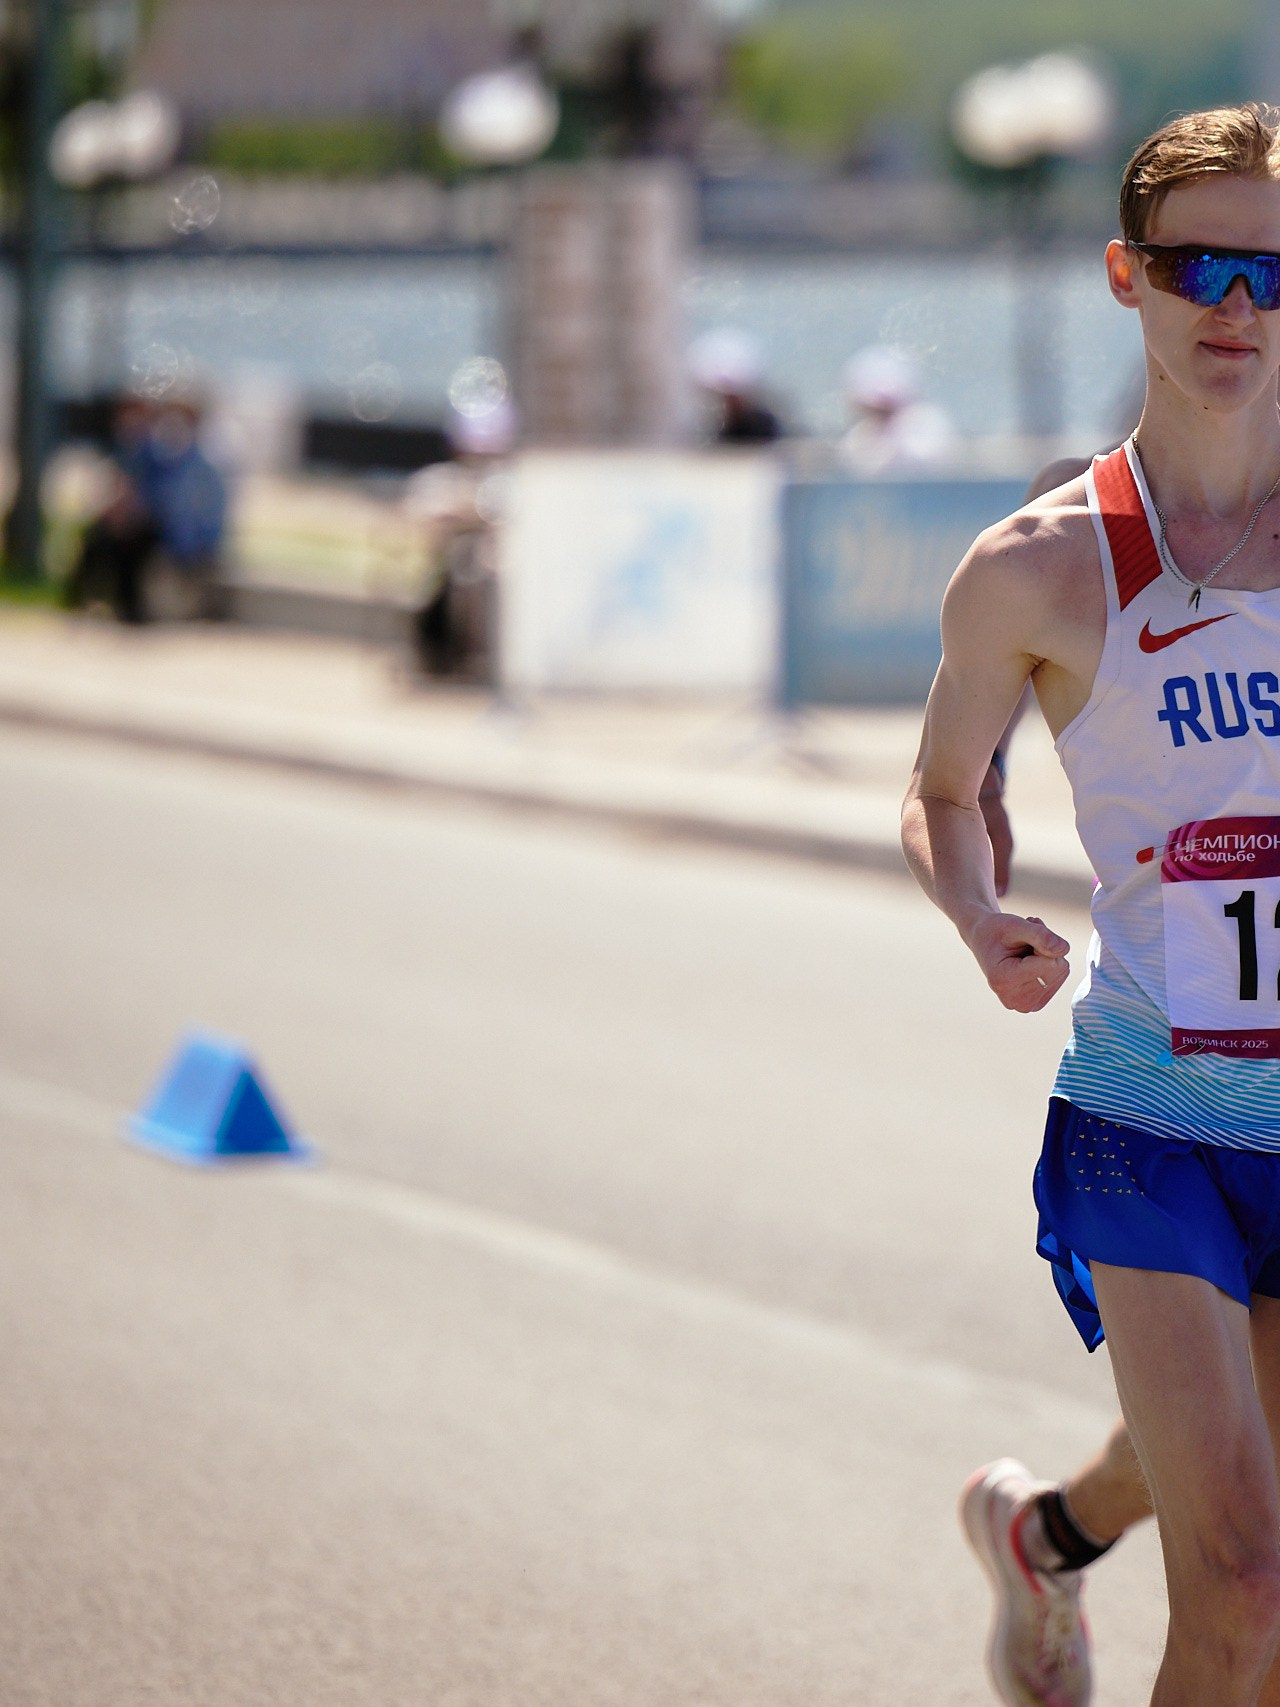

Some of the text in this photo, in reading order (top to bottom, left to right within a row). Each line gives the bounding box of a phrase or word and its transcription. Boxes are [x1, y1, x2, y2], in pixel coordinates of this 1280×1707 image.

[1174, 850, 1256, 863] по ходьбе
[1182, 1036, 1269, 1049] ВОТКИНСК 2025
